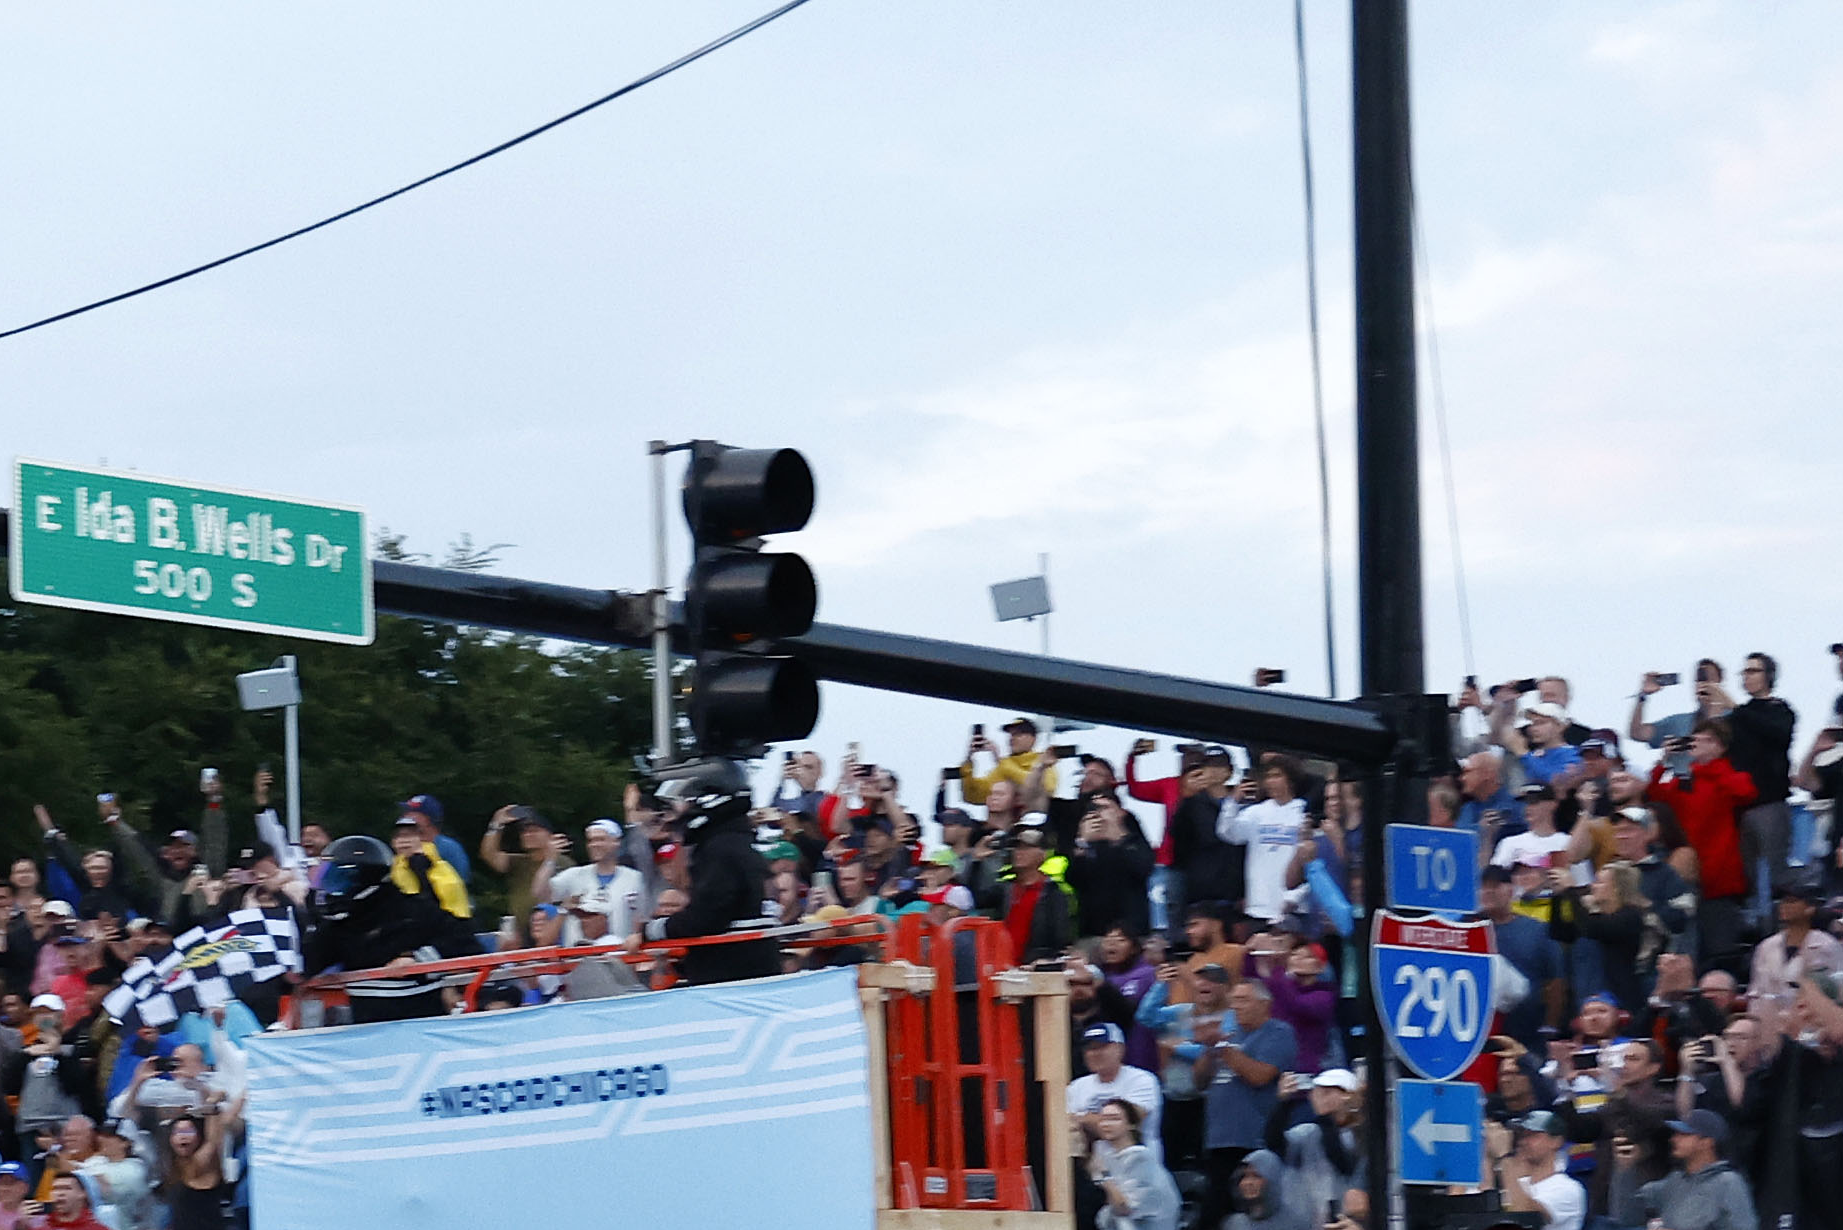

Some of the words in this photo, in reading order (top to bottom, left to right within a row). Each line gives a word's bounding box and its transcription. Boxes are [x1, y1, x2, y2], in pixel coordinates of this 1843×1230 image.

[35, 495, 63, 532] E
[74, 487, 136, 543] Ida
[147, 498, 187, 551] B.
[191, 503, 295, 566] Wells
[305, 534, 349, 572] Dr
[133, 560, 213, 602] 500
[231, 573, 258, 608] S
[1410, 846, 1457, 891] TO
[1393, 964, 1479, 1043] 290
